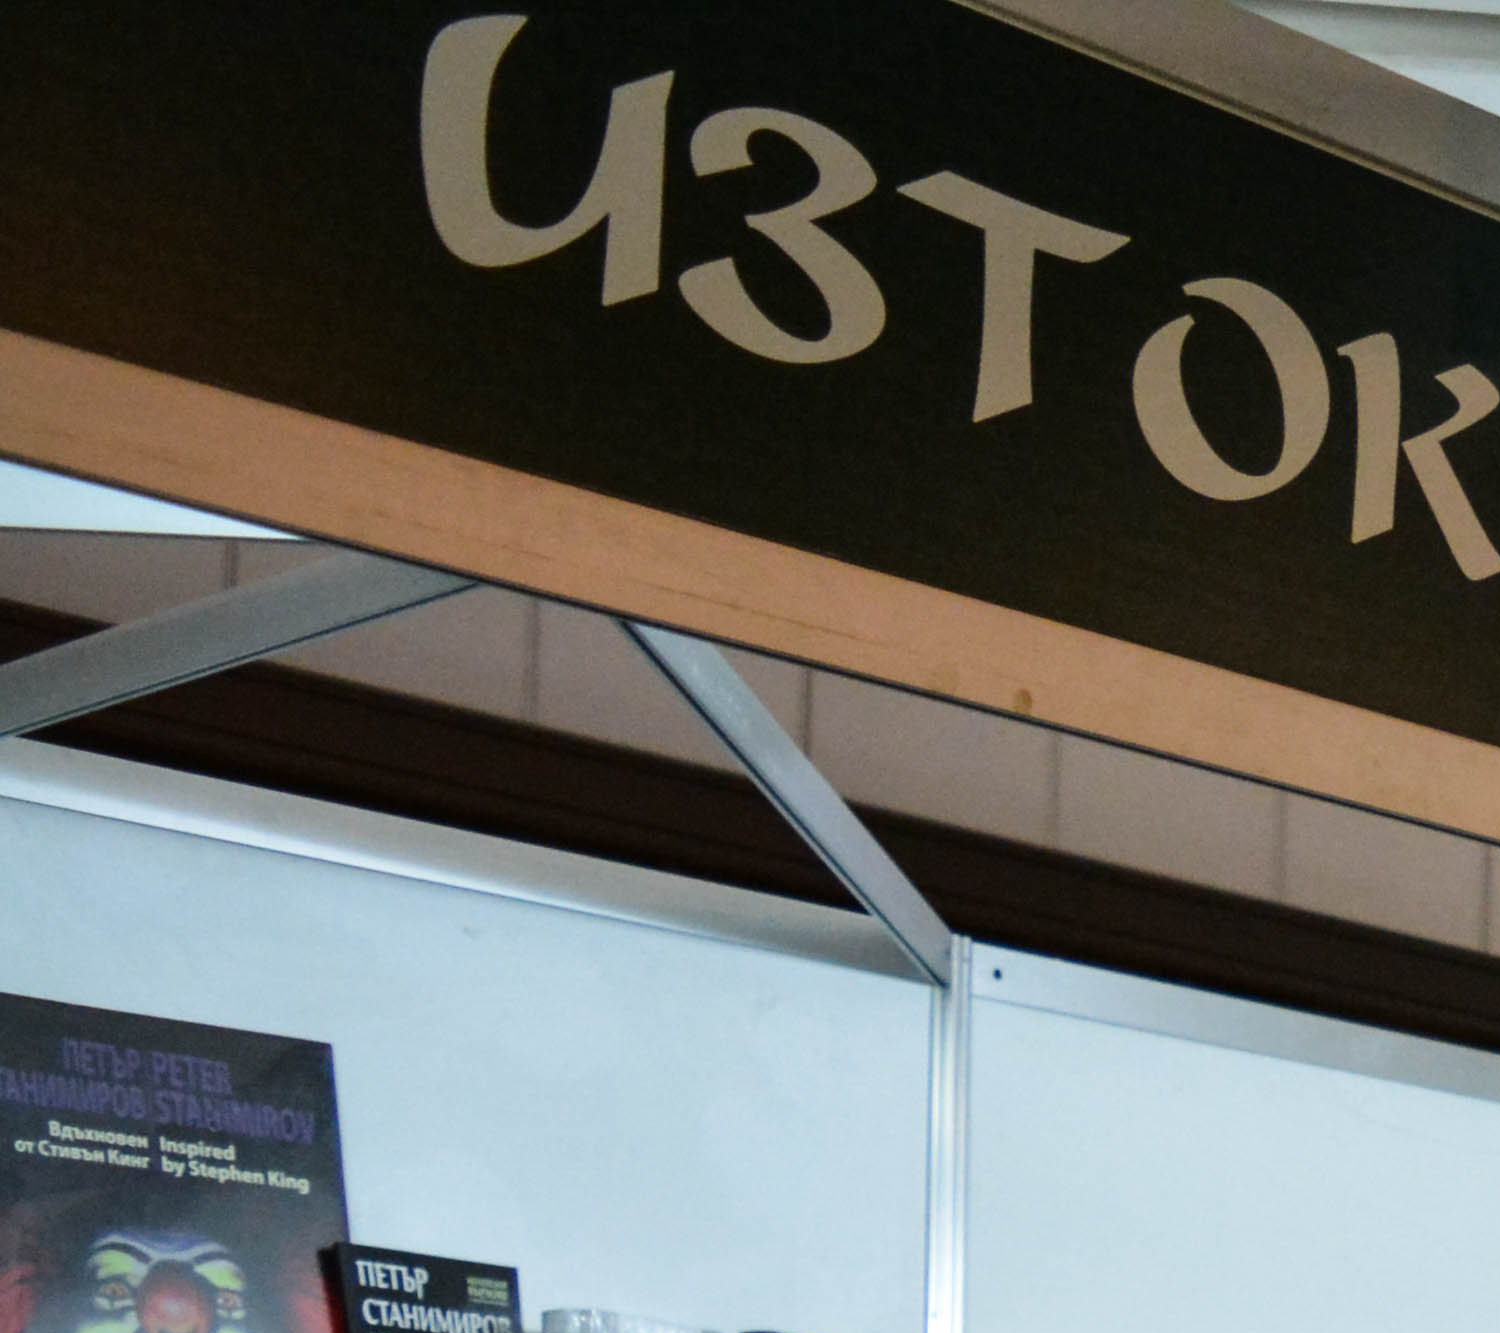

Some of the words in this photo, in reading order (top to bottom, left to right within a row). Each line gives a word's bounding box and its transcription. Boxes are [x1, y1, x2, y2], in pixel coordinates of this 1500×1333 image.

[62, 1036, 141, 1082] ПЕТЪР
[151, 1051, 233, 1096] PETER
[48, 1119, 149, 1149] Вдъхновен
[153, 1089, 317, 1145] STANIMIROV
[14, 1139, 35, 1154] от
[38, 1140, 105, 1163] Стивън
[108, 1149, 150, 1170] Кинг
[159, 1136, 237, 1162] Inspired
[160, 1155, 186, 1179] by
[189, 1160, 266, 1186] Stephen
[267, 1170, 311, 1196] King
[355, 1259, 430, 1300] ПЕТЪР
